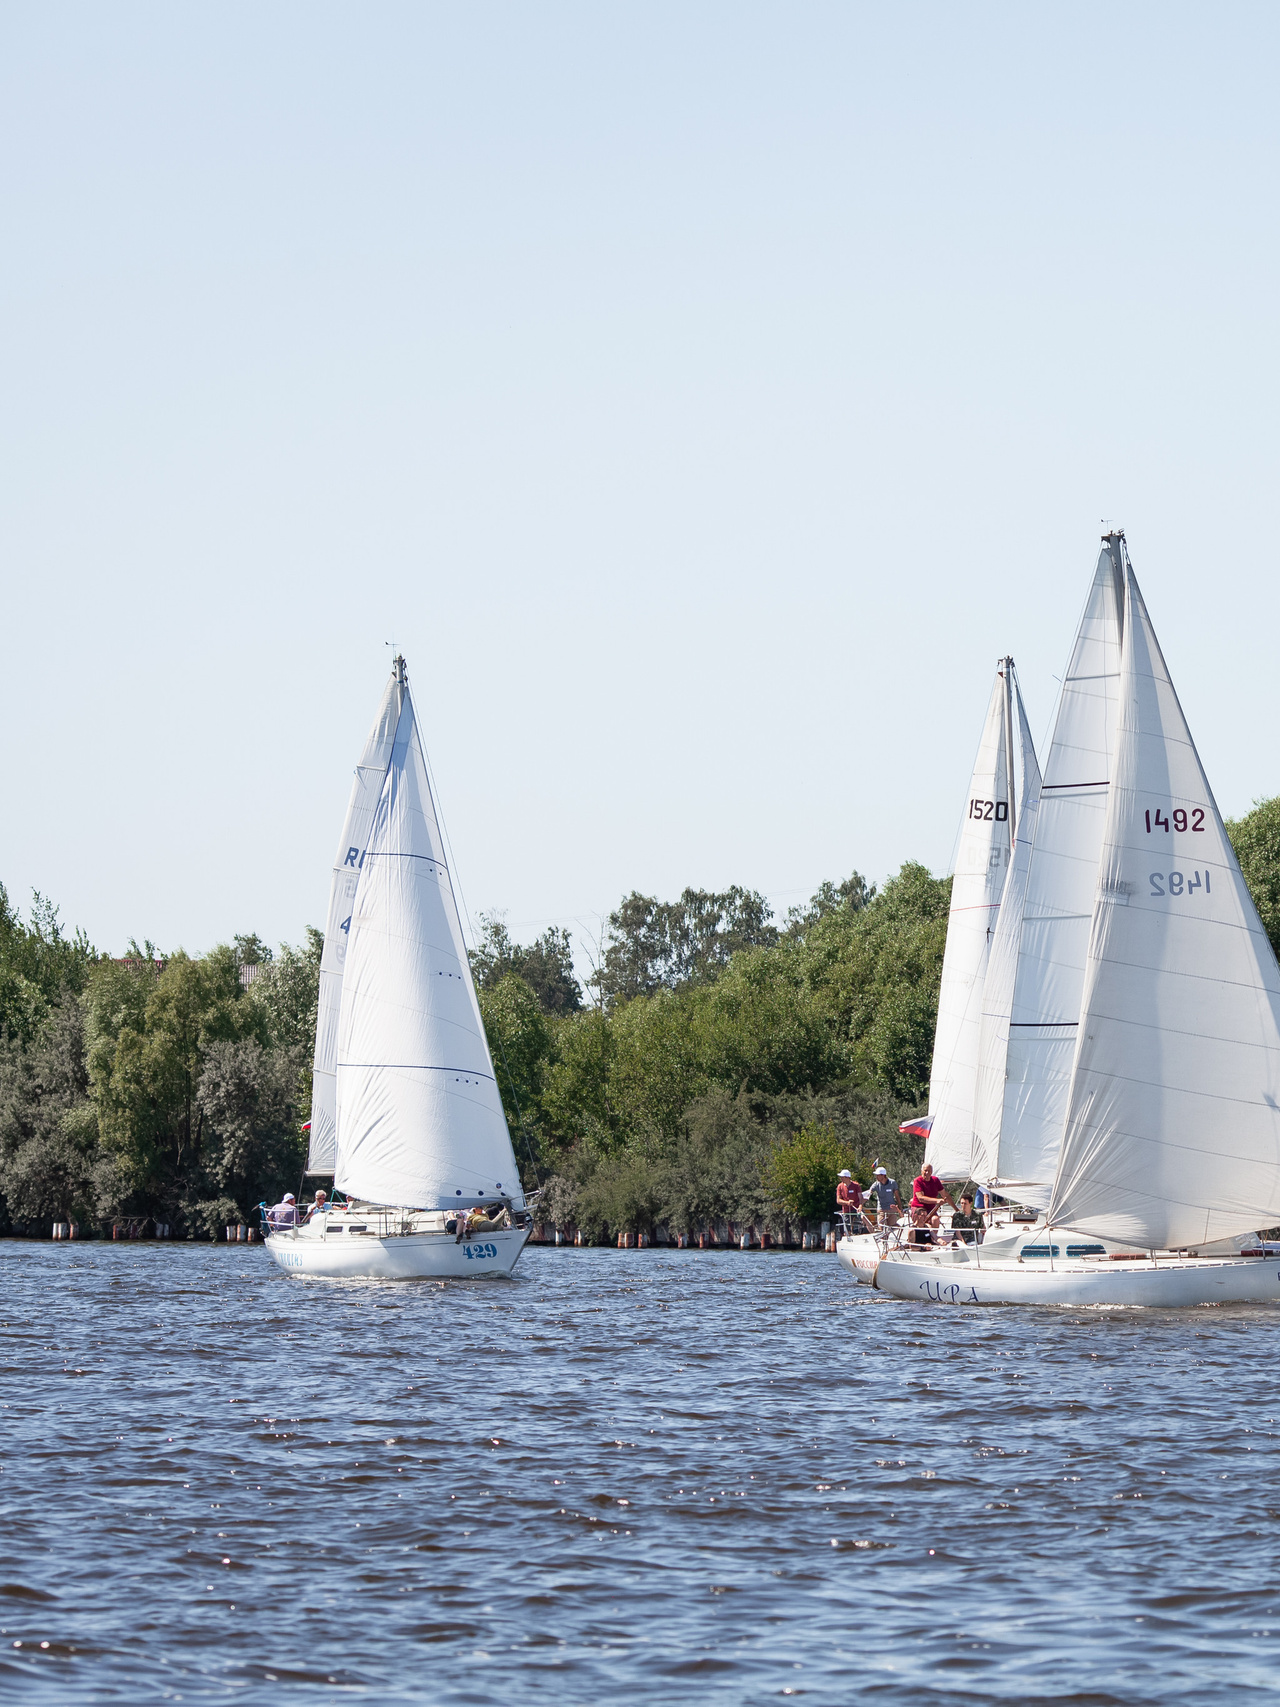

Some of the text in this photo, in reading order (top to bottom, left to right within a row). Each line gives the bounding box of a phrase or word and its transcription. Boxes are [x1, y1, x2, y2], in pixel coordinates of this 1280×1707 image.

[968, 798, 1009, 822] 1520
[1144, 808, 1205, 834] 1492
[462, 1243, 498, 1260] 429
